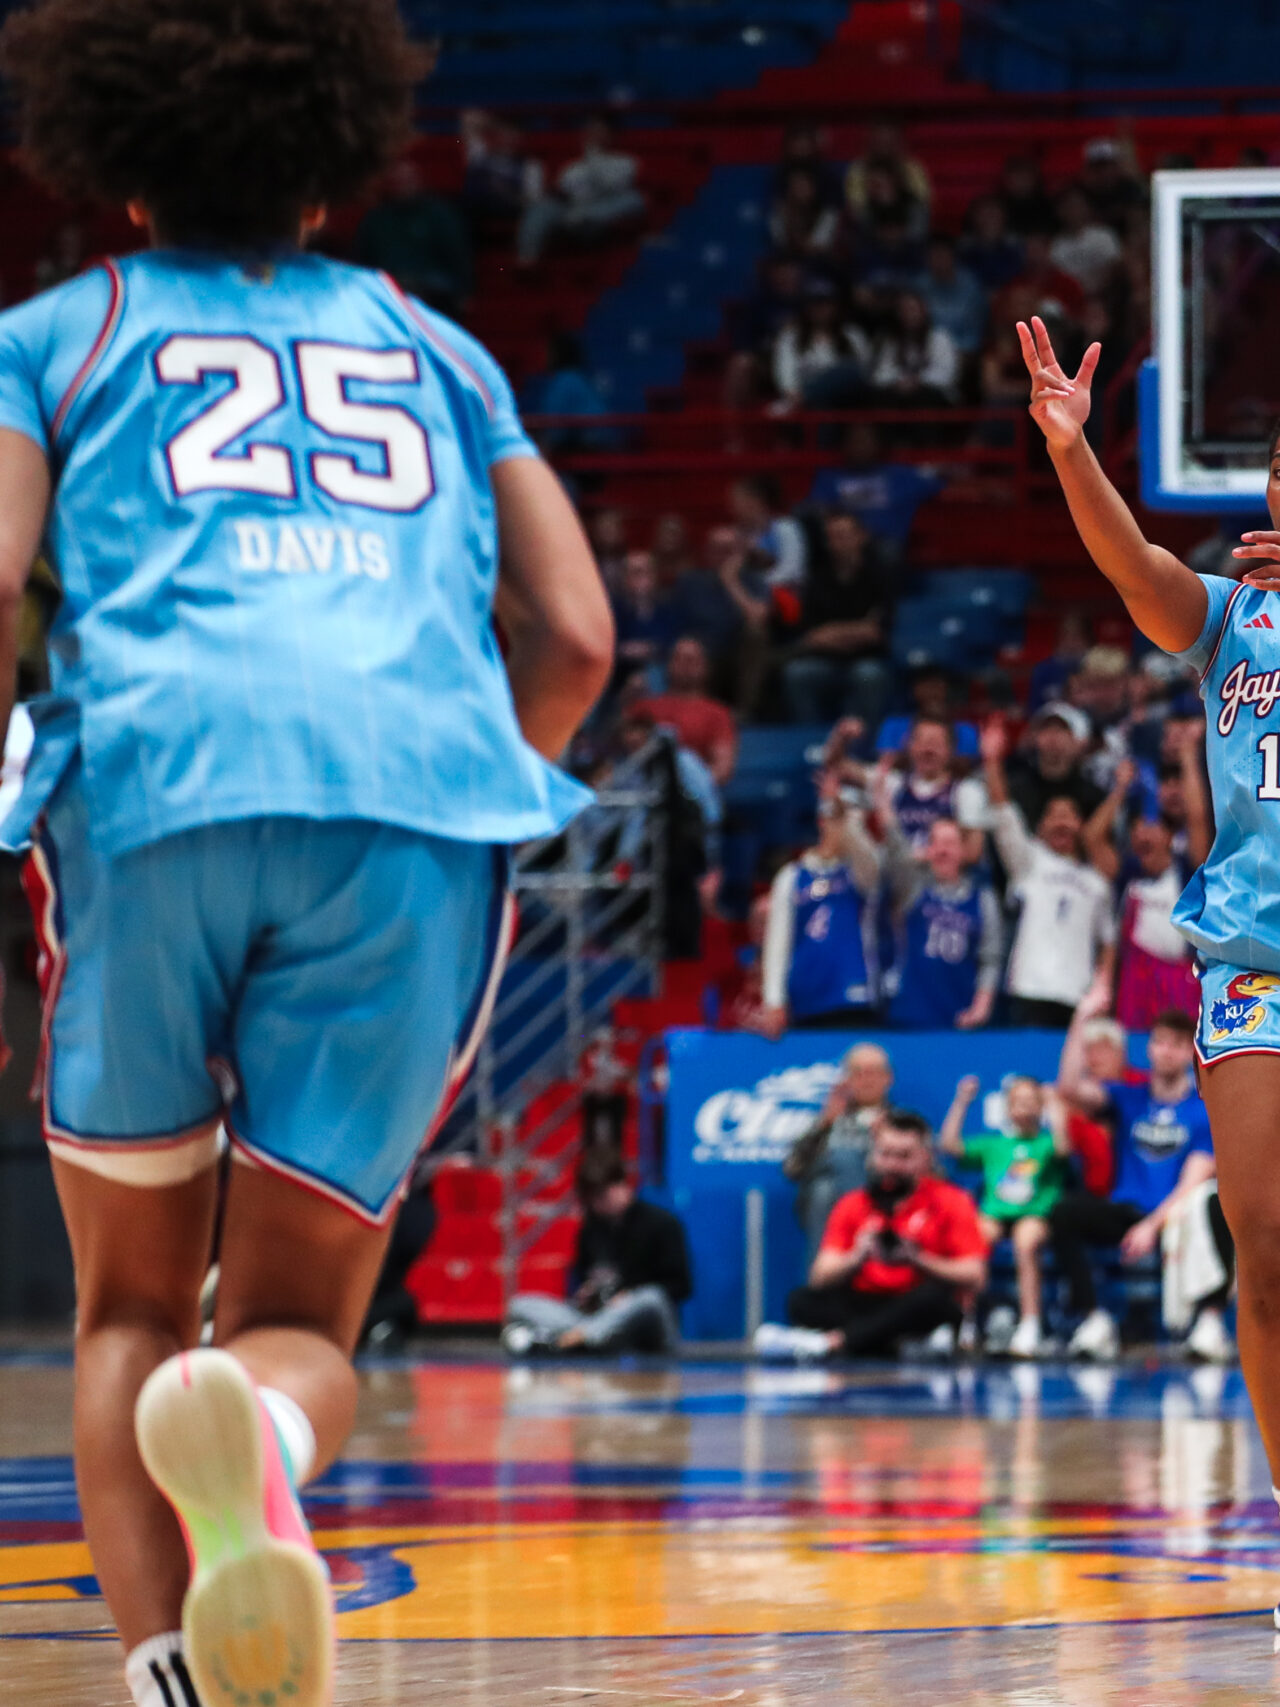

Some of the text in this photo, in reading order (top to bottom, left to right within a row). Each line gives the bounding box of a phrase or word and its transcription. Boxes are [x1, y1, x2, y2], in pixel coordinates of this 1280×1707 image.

[153, 332, 436, 514] 25
[233, 519, 391, 582] DAVIS
[1225, 1003, 1244, 1019] KU
